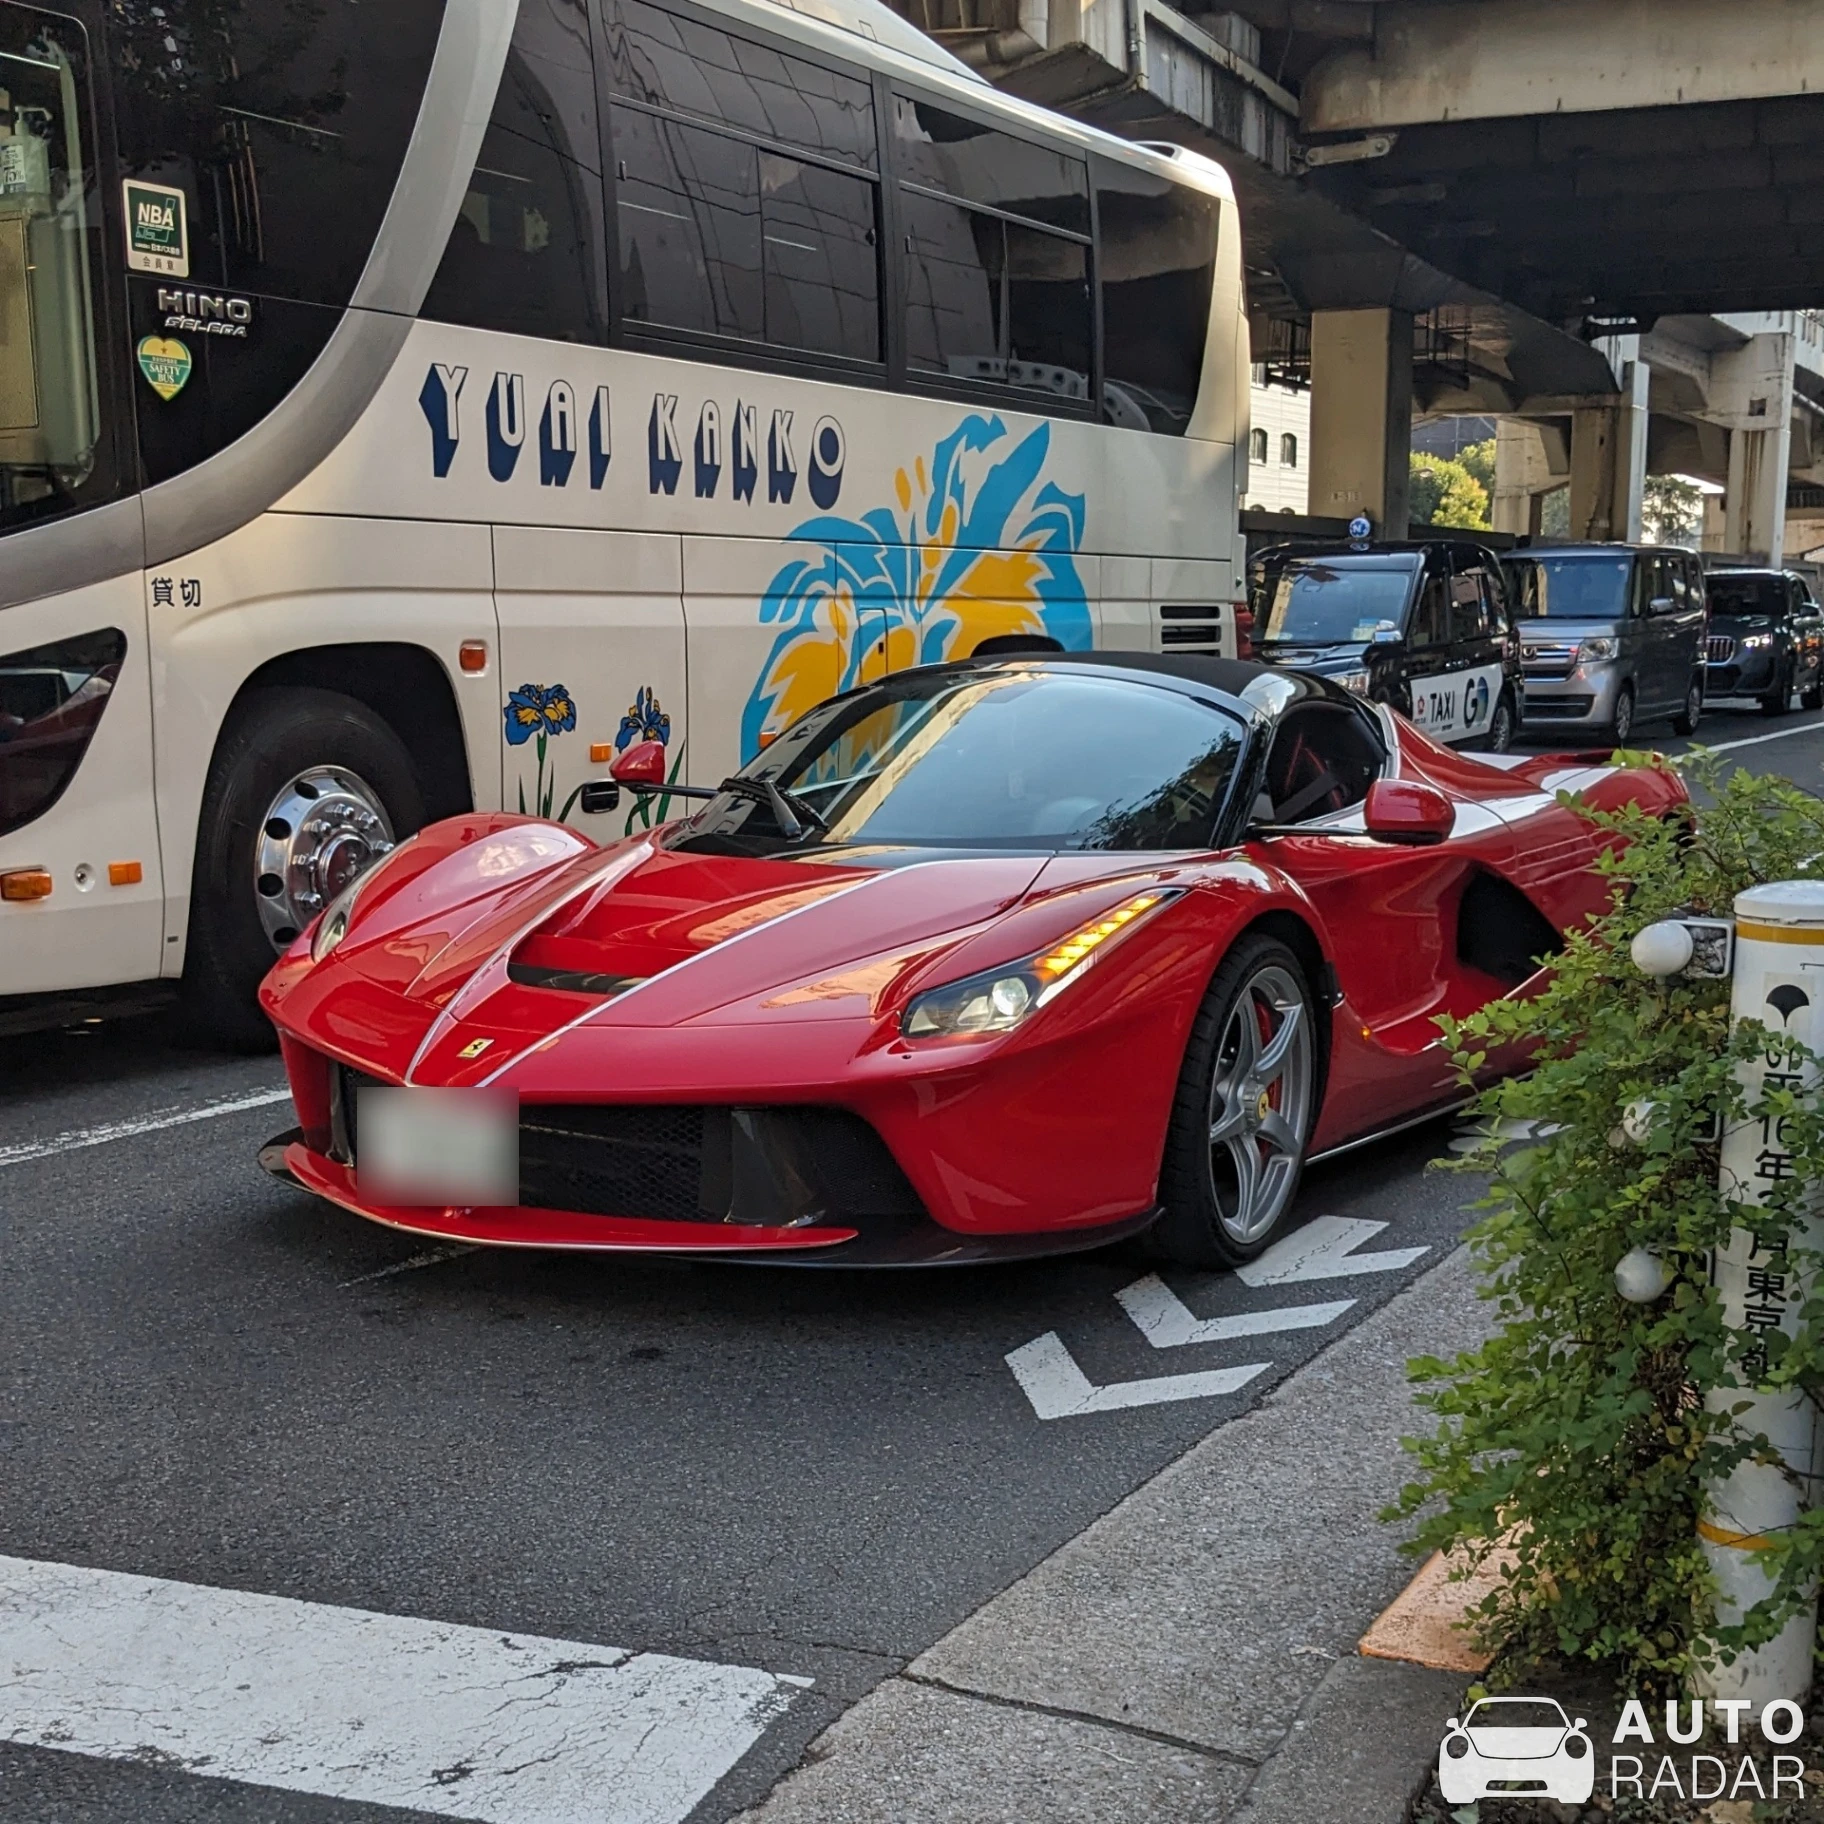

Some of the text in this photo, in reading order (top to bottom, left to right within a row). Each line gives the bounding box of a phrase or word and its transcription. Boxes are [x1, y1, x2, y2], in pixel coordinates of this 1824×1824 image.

[138, 202, 174, 227] NBA
[158, 289, 252, 324] HINO
[150, 363, 180, 376] SAFETY
[158, 373, 175, 383] BUS
[419, 363, 846, 510] YUAI KANKO
[151, 577, 201, 608] 貸切
[1430, 691, 1455, 723] TAXI
